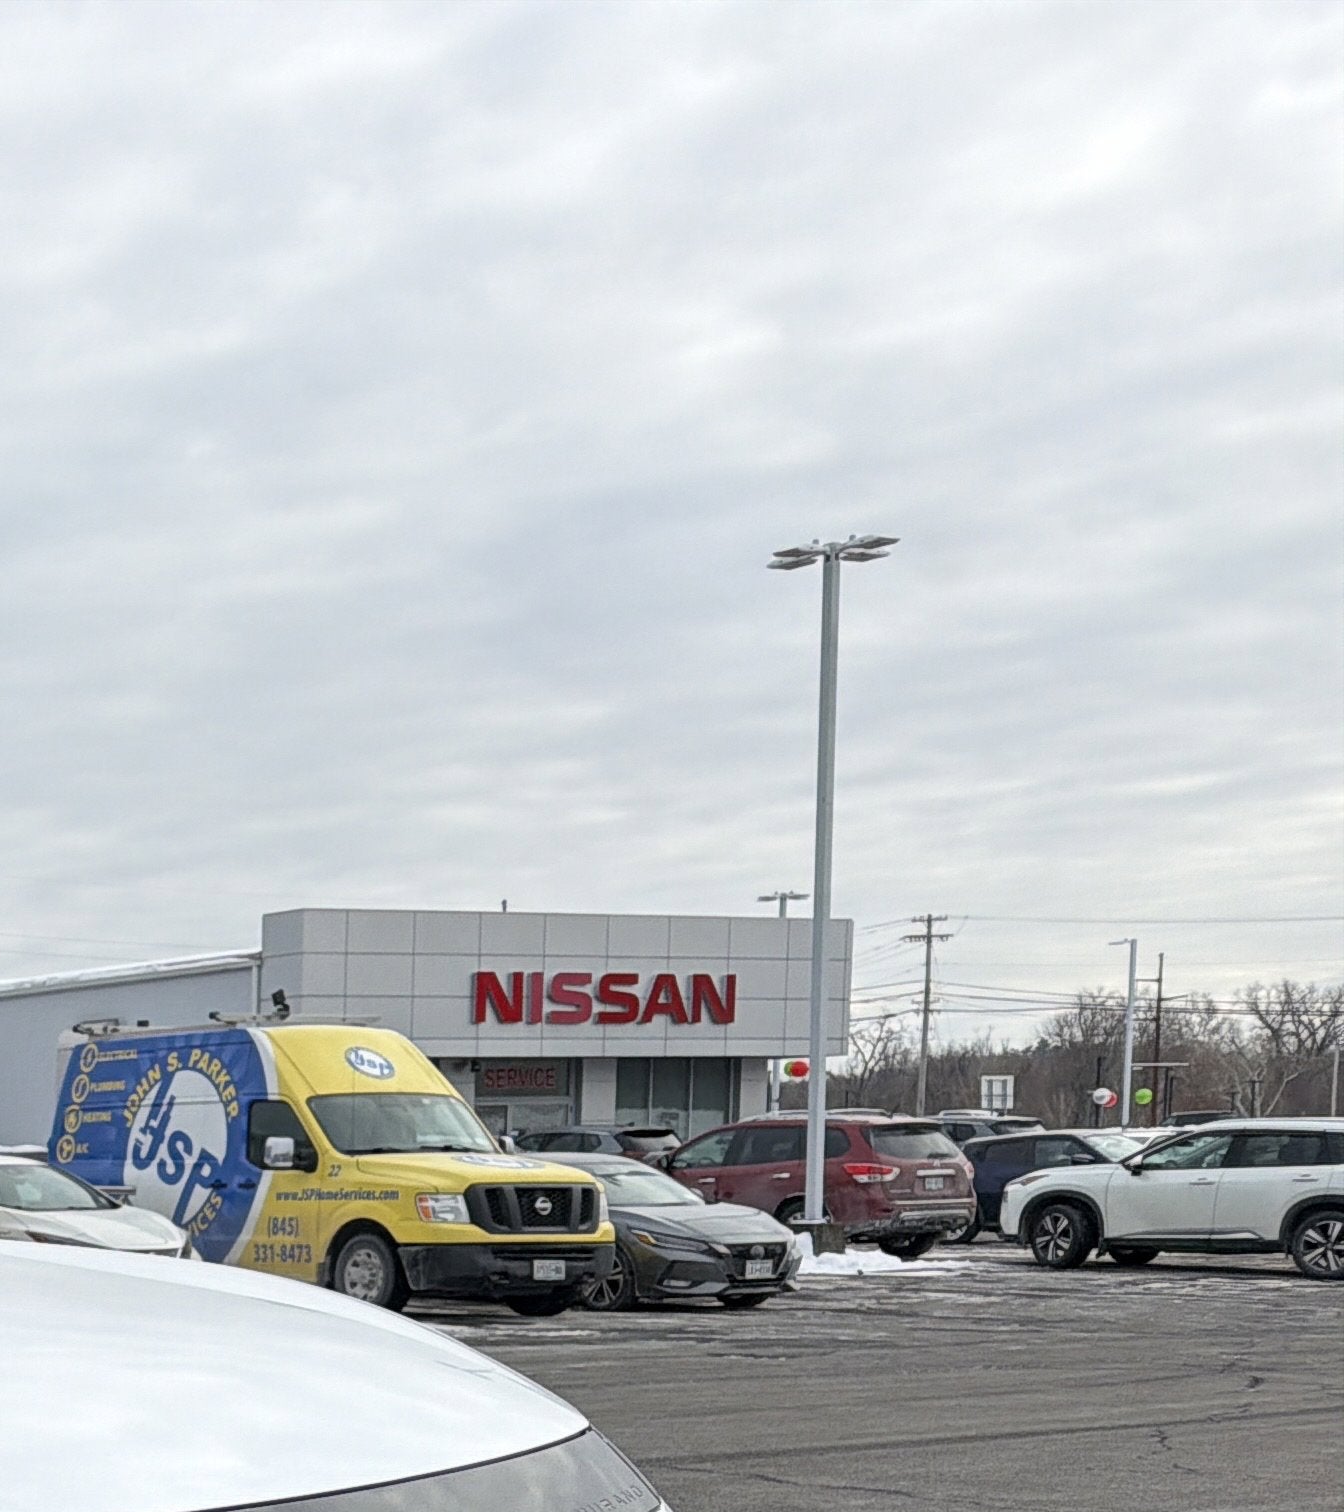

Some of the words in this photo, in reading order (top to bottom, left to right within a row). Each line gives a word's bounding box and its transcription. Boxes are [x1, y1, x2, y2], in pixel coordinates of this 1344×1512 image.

[473, 971, 737, 1025] NISSAN
[123, 1063, 162, 1127] JOHN
[167, 1051, 183, 1072] S.
[189, 1048, 239, 1123] PARKER
[483, 1066, 556, 1089] SERVICE
[132, 1084, 222, 1225] JSP
[328, 1164, 342, 1177] 22
[275, 1188, 400, 1202] www.JSPHomeServices.com
[188, 1191, 223, 1238] ICES
[267, 1215, 300, 1237] (845)
[254, 1243, 312, 1264] 331-8473
